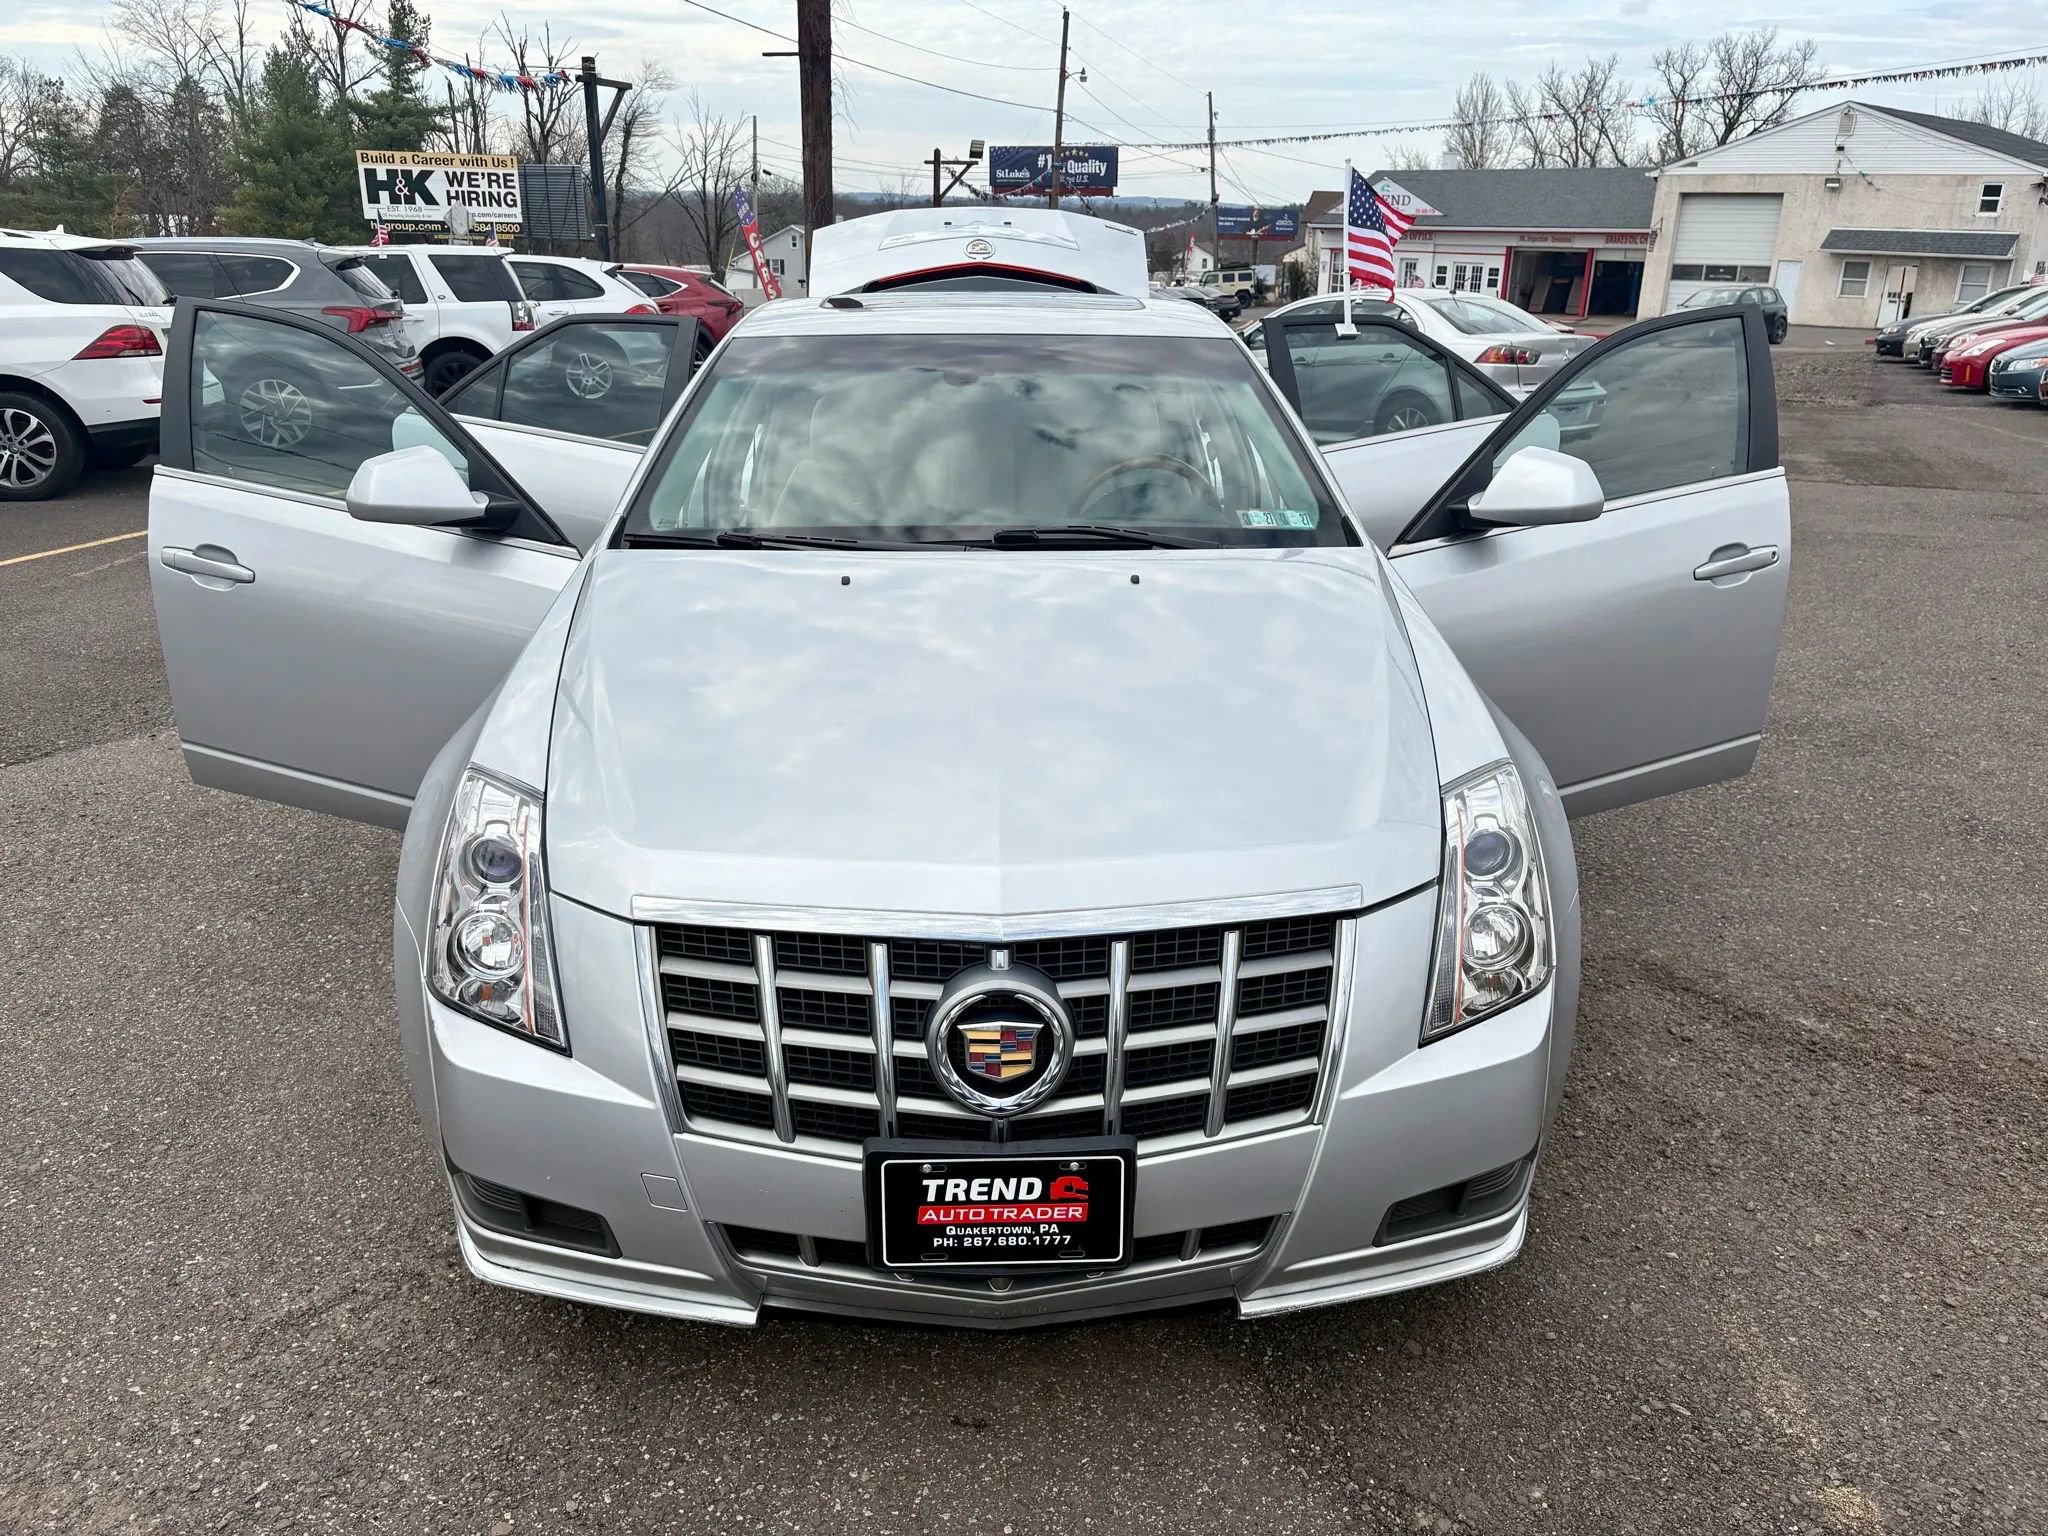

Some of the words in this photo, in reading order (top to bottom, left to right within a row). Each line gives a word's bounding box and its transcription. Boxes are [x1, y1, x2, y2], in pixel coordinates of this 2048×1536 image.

[360, 152, 395, 164] Build
[399, 156, 407, 164] a
[411, 154, 455, 166] Career
[459, 156, 488, 167] with
[1067, 160, 1107, 176] Quality
[364, 168, 440, 206] H&K
[444, 170, 516, 189] WE'RE
[1076, 175, 1089, 183] U.S.
[446, 190, 517, 208] HIRING
[922, 1177, 1042, 1202] TREND
[922, 1208, 985, 1222] AUTO
[989, 1206, 1083, 1221] TRADER
[1039, 1224, 1059, 1234] PA
[933, 1237, 958, 1248] PH:
[963, 1235, 1071, 1248] 267.680.1777
